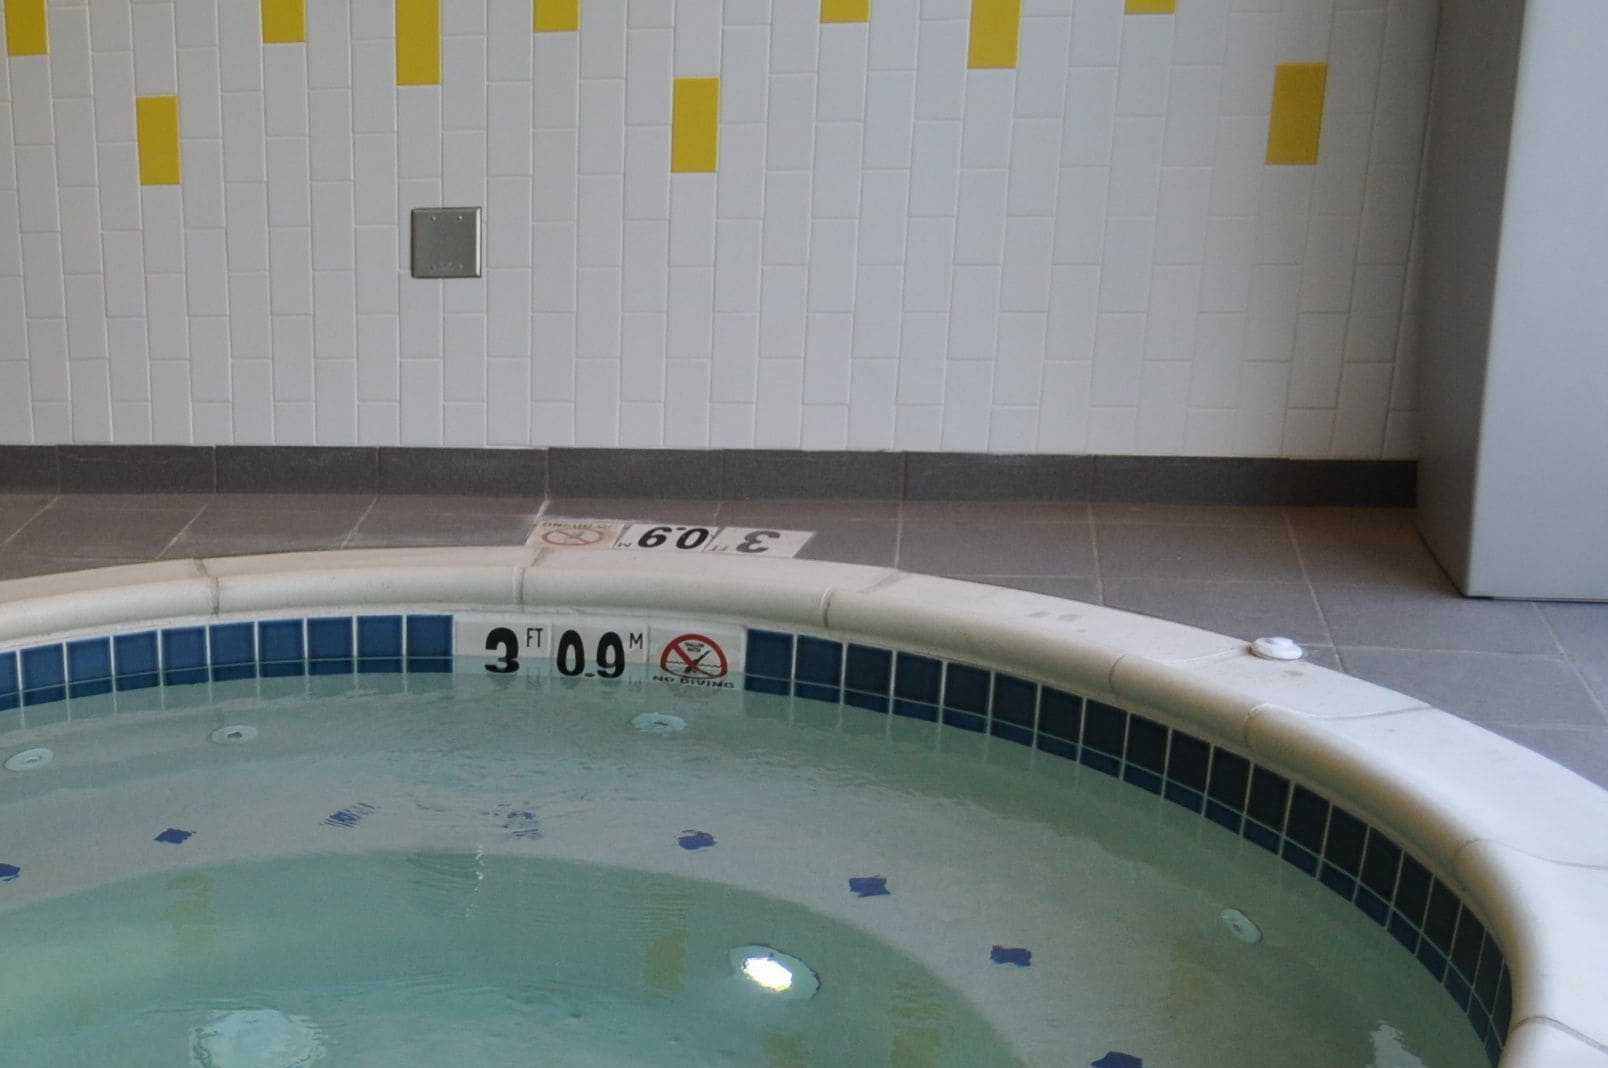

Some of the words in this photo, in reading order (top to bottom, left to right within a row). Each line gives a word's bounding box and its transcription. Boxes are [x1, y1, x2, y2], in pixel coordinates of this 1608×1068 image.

[637, 526, 709, 550] 0.9
[736, 530, 781, 553] 3
[485, 627, 520, 674] 3
[526, 628, 543, 648] FT
[556, 629, 625, 679] 0.9
[629, 632, 643, 649] M
[680, 678, 735, 688] DIVING
